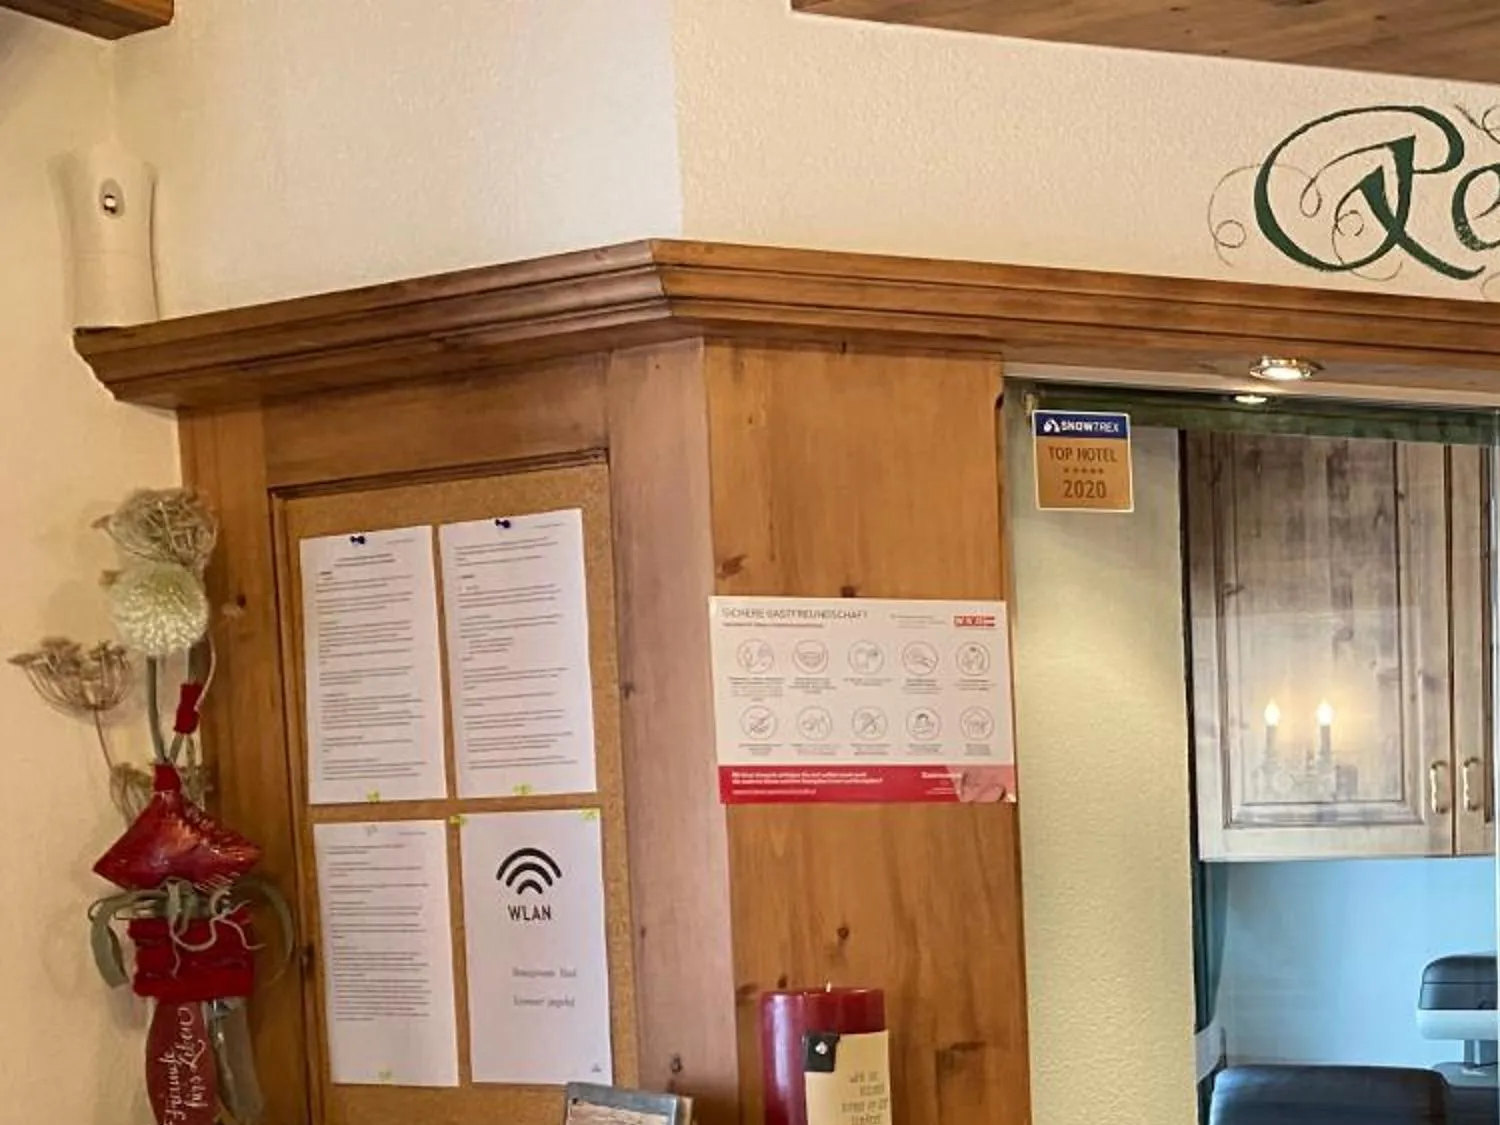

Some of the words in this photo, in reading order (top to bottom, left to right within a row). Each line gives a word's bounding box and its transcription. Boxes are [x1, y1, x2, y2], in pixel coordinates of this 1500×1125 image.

[1060, 420, 1119, 433] SNOWTREX
[1049, 446, 1073, 460] TOP
[1076, 447, 1118, 462] HOTEL
[1064, 480, 1107, 499] 2020
[507, 904, 552, 921] WLAN
